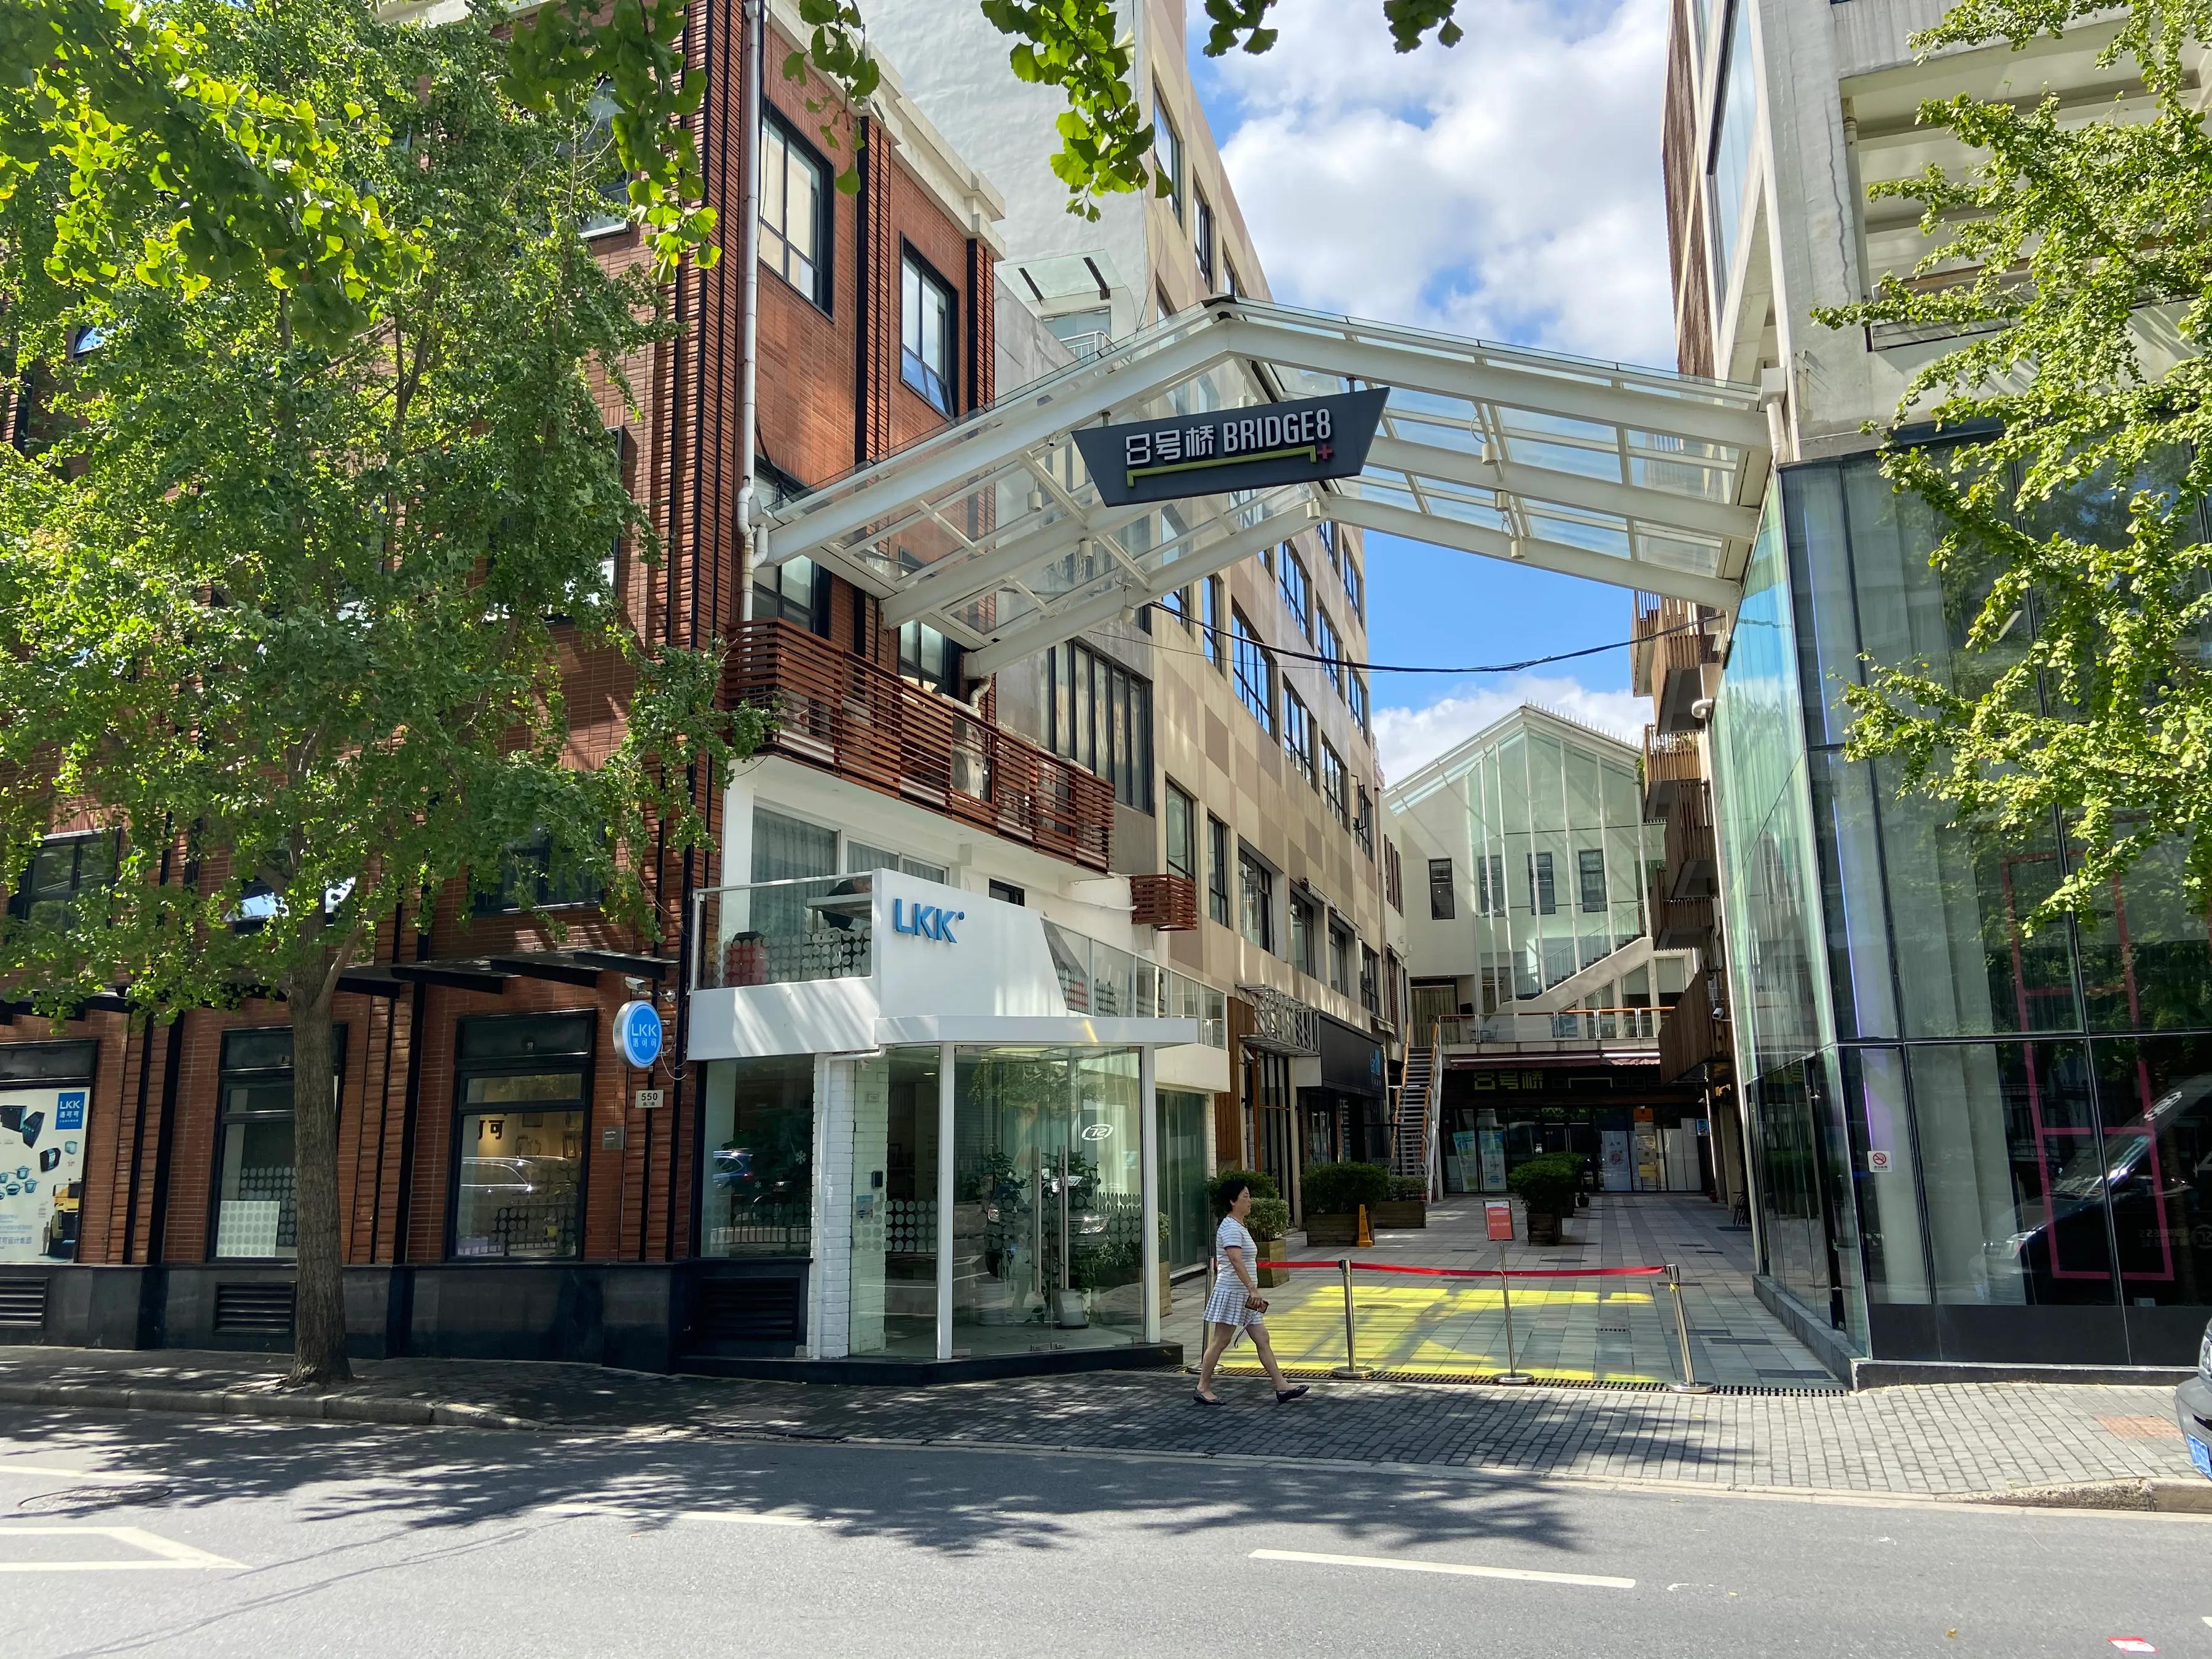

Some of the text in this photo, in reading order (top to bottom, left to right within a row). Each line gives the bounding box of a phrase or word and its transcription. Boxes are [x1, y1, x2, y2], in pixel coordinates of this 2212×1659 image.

[1223, 408, 1332, 453] BRIDGE8
[894, 898, 957, 944] LKK
[632, 1023, 657, 1037] LKK
[633, 1037, 657, 1048] 洛可可
[641, 1092, 658, 1101] 550
[60, 1100, 81, 1110] LKK
